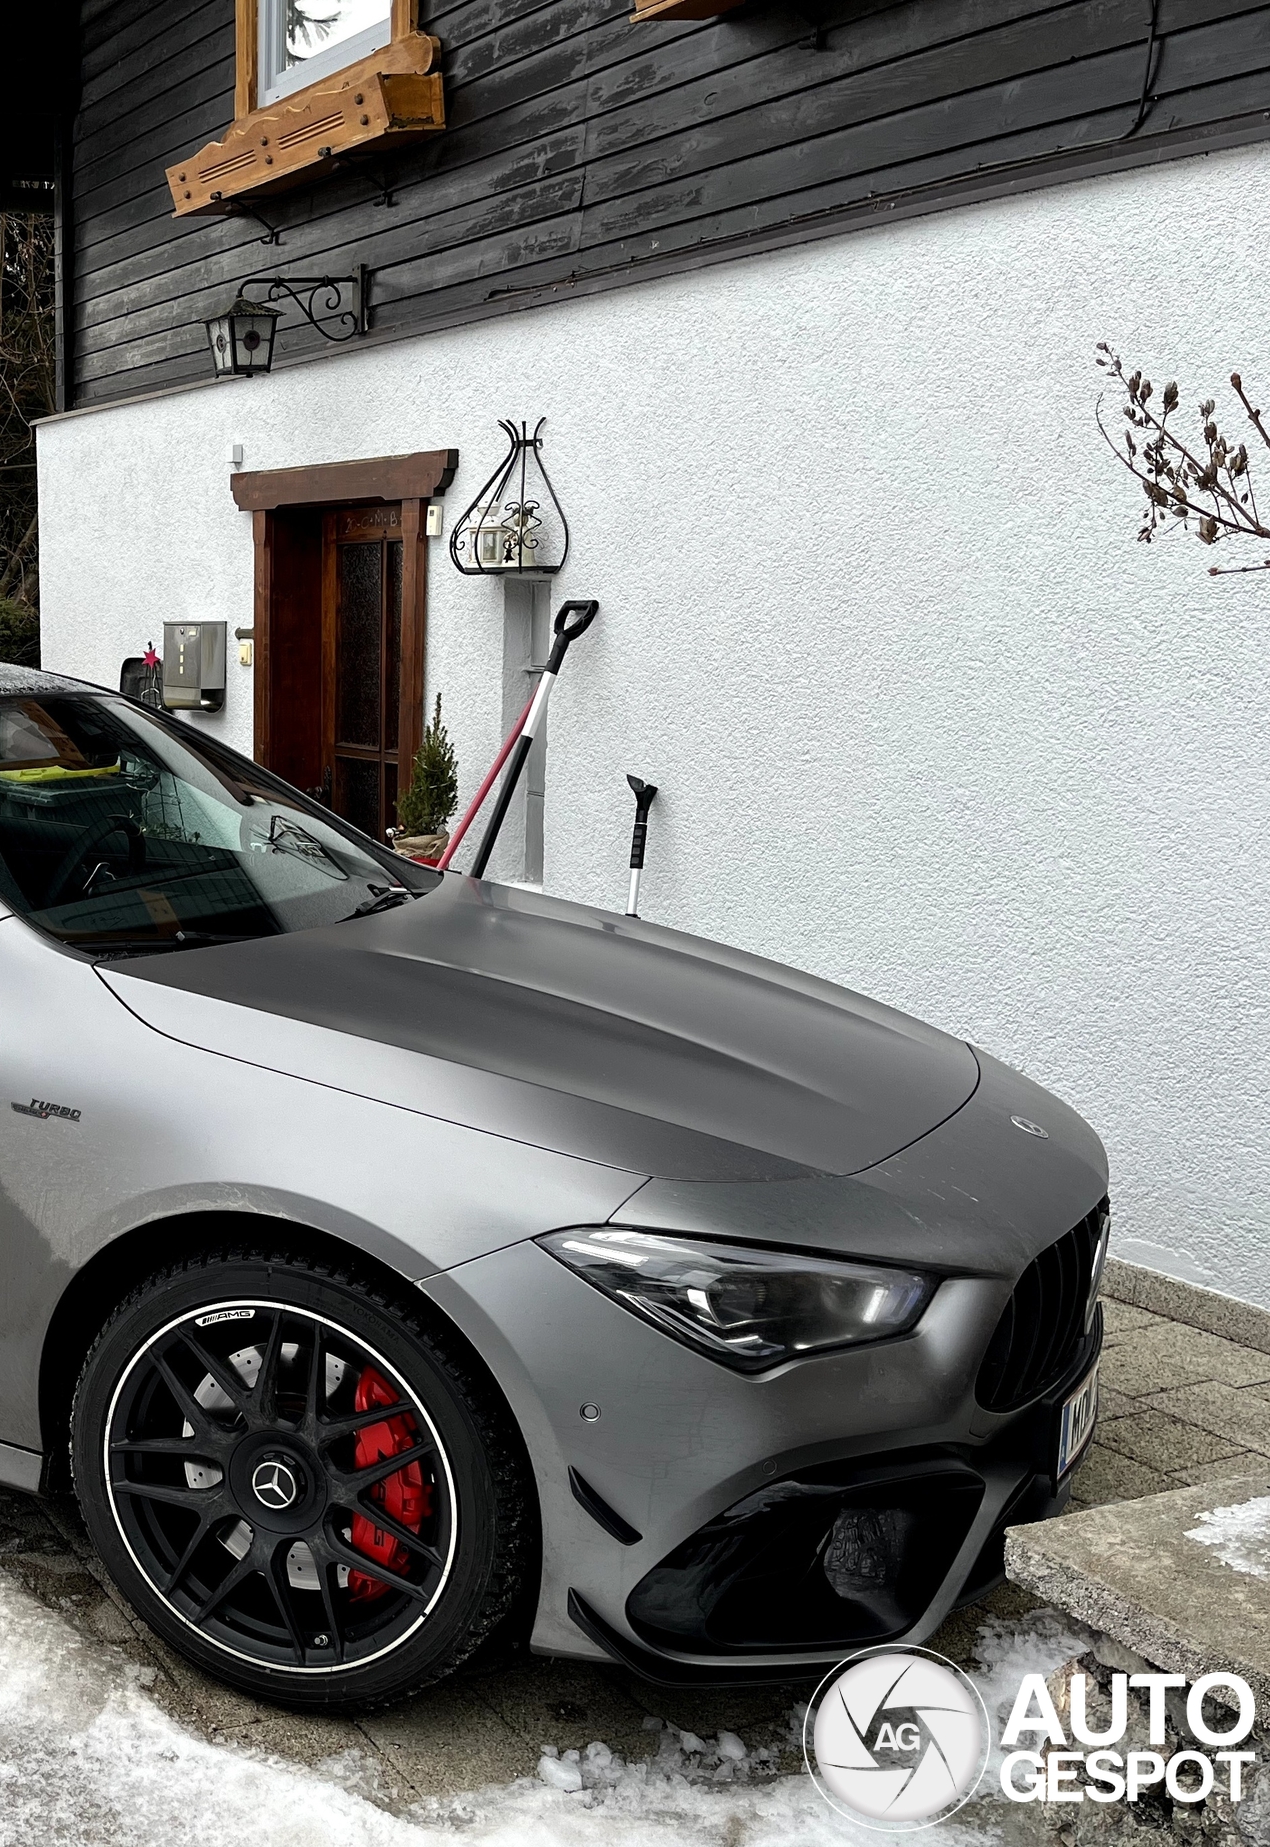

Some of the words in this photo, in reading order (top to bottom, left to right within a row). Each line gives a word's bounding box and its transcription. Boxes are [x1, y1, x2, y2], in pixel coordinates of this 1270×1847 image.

[30, 1098, 81, 1119] TURBO
[216, 1310, 251, 1321] AMG
[352, 1304, 400, 1344] YOKOHAMA
